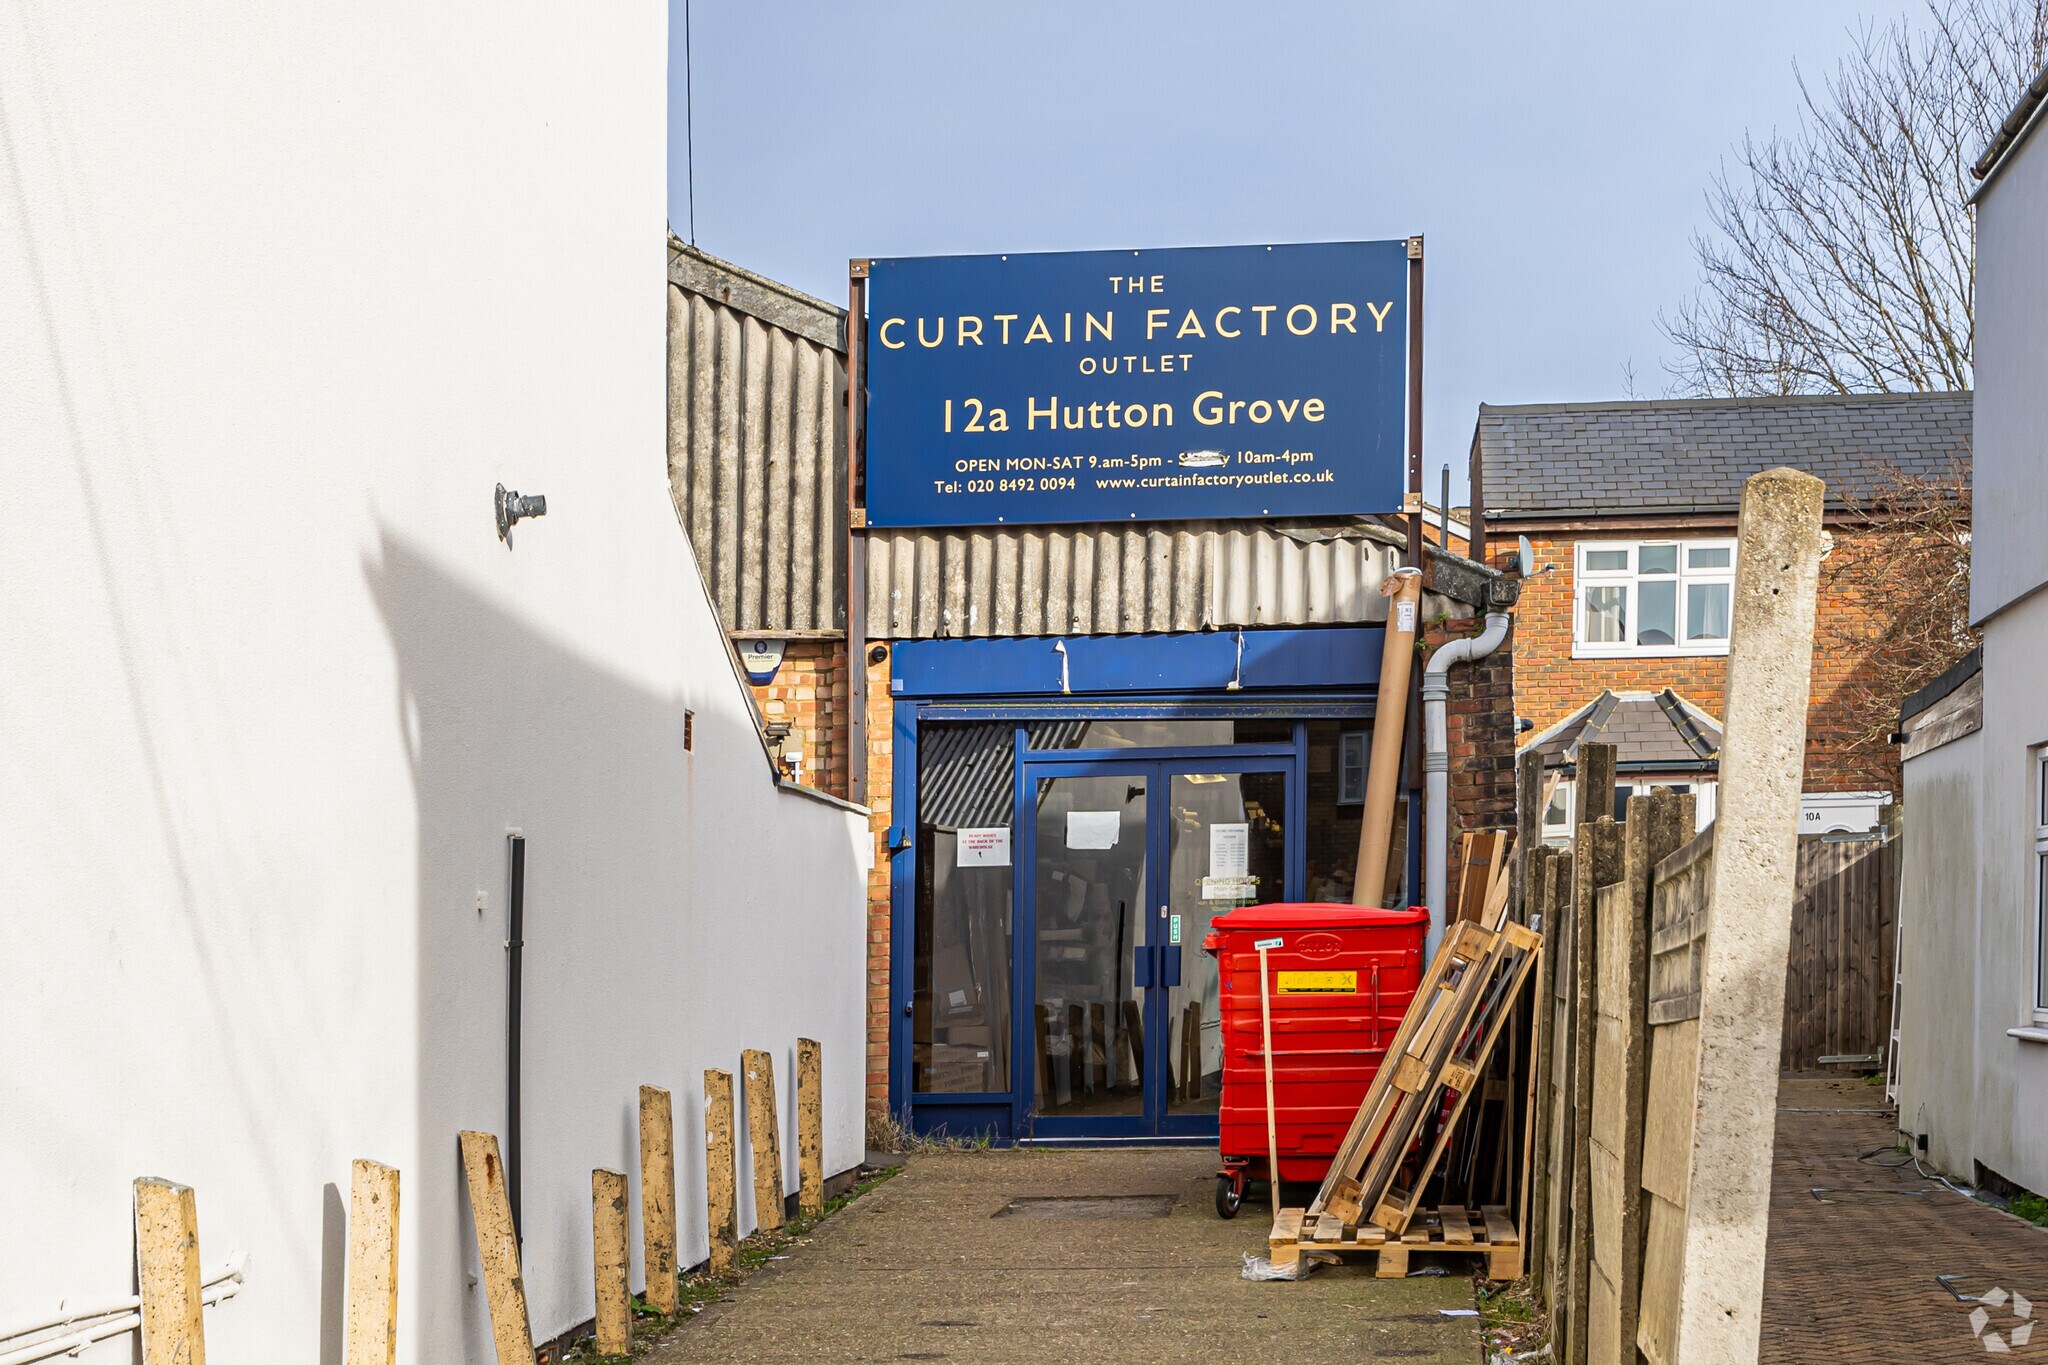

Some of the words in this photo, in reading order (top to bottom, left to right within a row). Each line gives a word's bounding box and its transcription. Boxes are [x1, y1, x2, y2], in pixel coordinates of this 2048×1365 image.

[1109, 275, 1164, 294] THE
[880, 311, 1113, 349] CURTAIN
[1146, 301, 1394, 340] FACTORY
[1079, 354, 1193, 375] OUTLET
[944, 398, 1010, 433] 12a
[1027, 396, 1173, 431] Hutton
[1192, 391, 1325, 426] Grove
[955, 458, 1001, 473] OPEN
[1006, 456, 1084, 471] MON-SAT
[1088, 455, 1162, 471] 9.am-5pm
[1237, 449, 1314, 466] 10am-4pm
[933, 480, 962, 494] Tel:
[967, 479, 995, 493] 020
[999, 478, 1035, 492] 8492
[1039, 477, 1076, 491] 0094
[1096, 468, 1335, 489] www.curtainfactoryoutlet.co.uk
[1805, 812, 1821, 821] 10A
[1195, 878, 1230, 886] OPENING
[1298, 942, 1341, 953] TAYLOR
